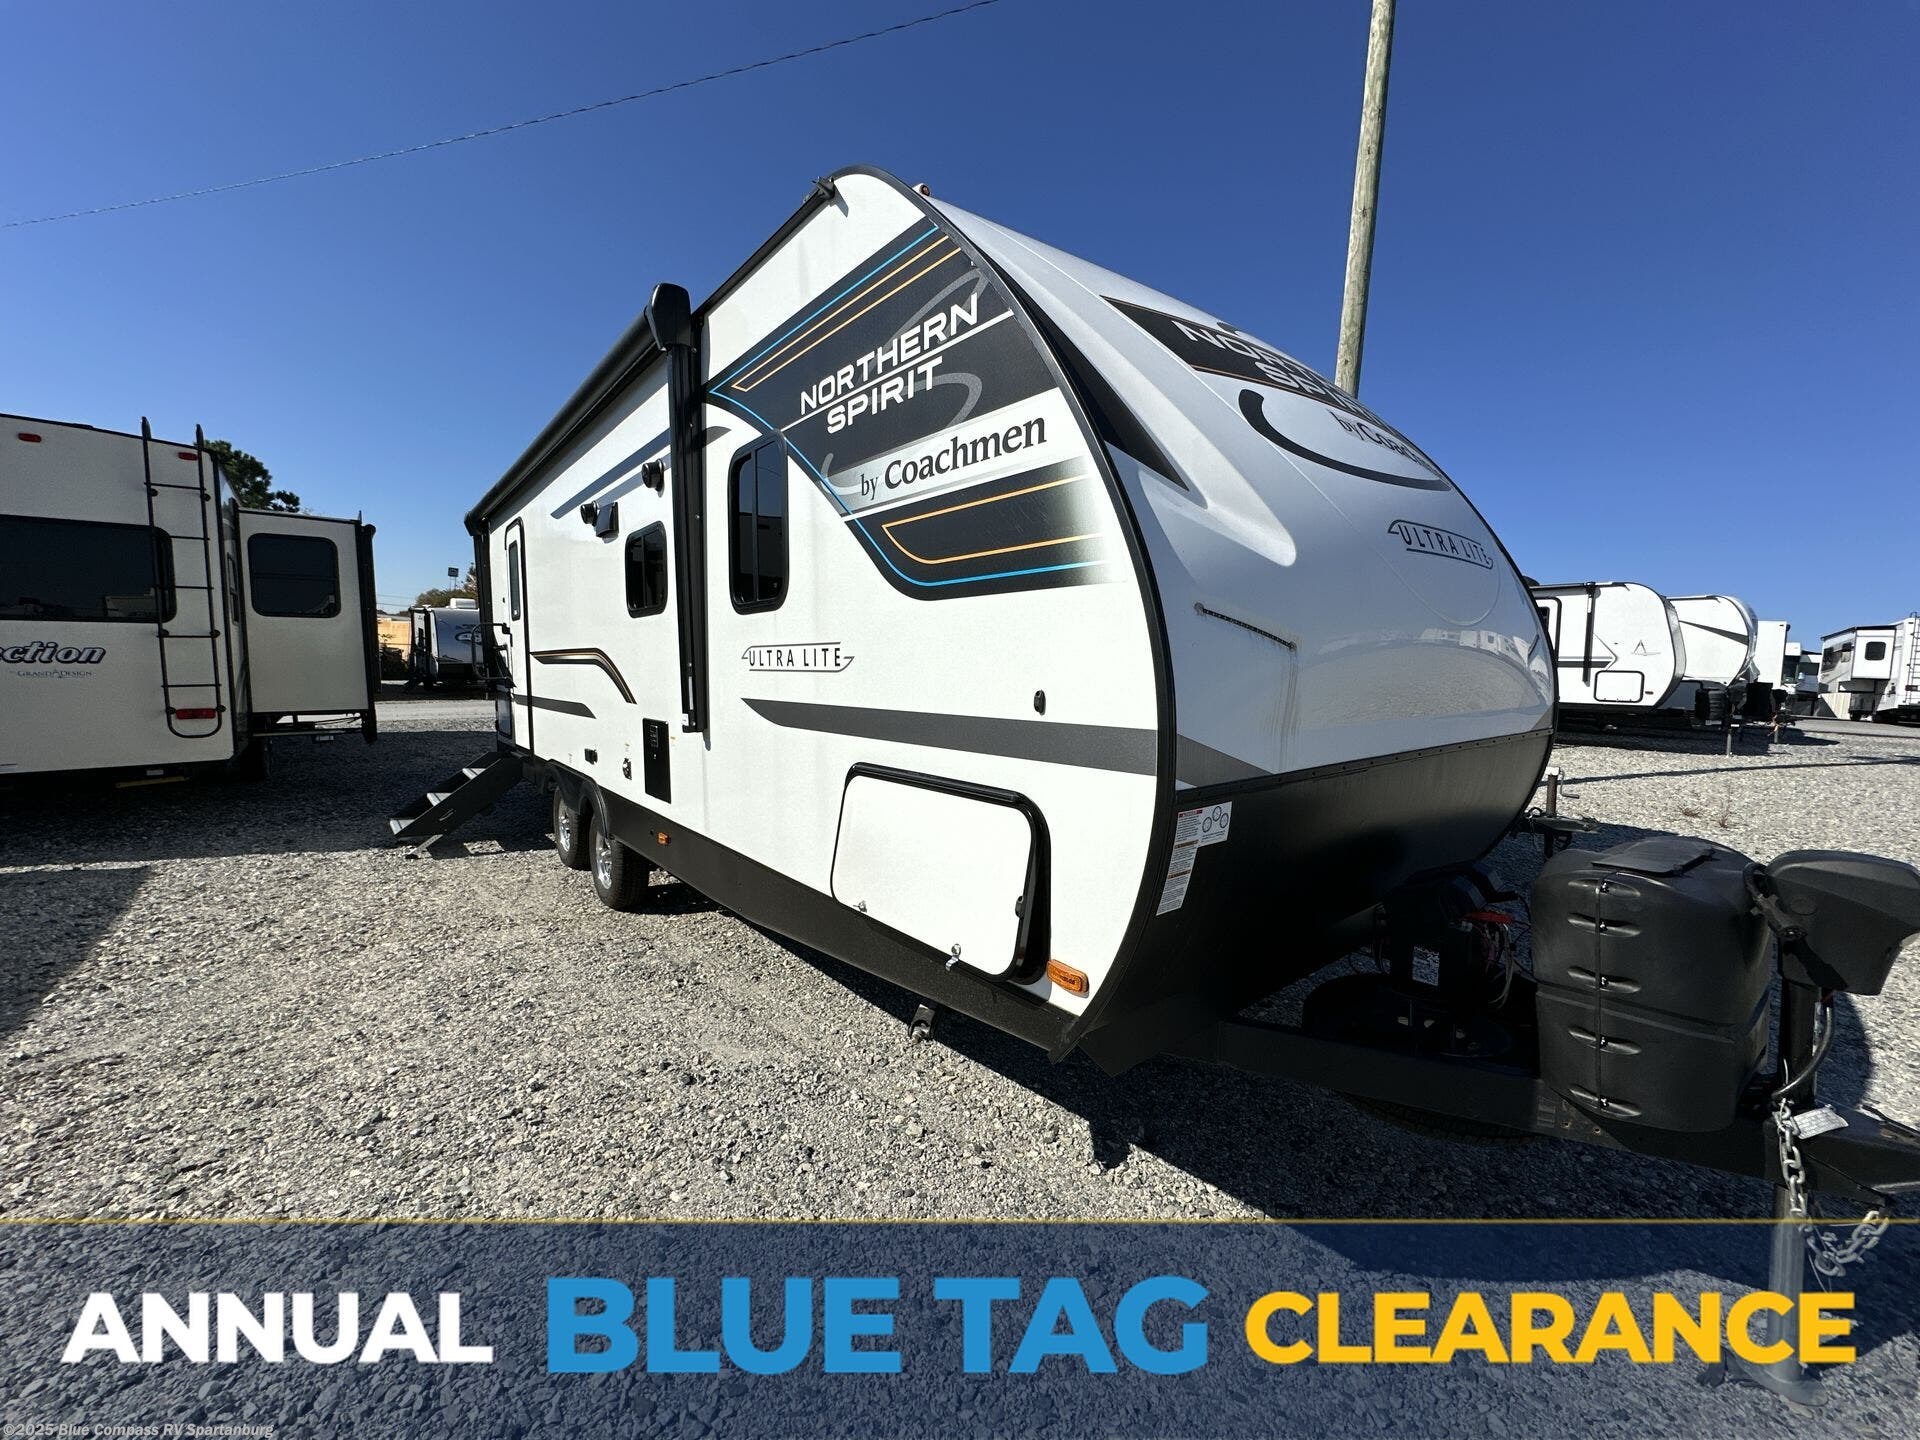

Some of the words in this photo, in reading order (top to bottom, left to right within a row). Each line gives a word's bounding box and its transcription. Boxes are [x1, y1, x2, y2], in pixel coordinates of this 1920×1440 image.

[800, 292, 979, 416] NORTHERN
[827, 355, 943, 435] SPIRIT
[860, 473, 880, 500] by
[884, 416, 1048, 490] Coachmen
[1397, 524, 1459, 555] ULTRA
[1460, 540, 1490, 565] LITE
[0, 641, 107, 664] ction
[748, 648, 795, 667] ULTRA
[803, 647, 841, 667] LITE
